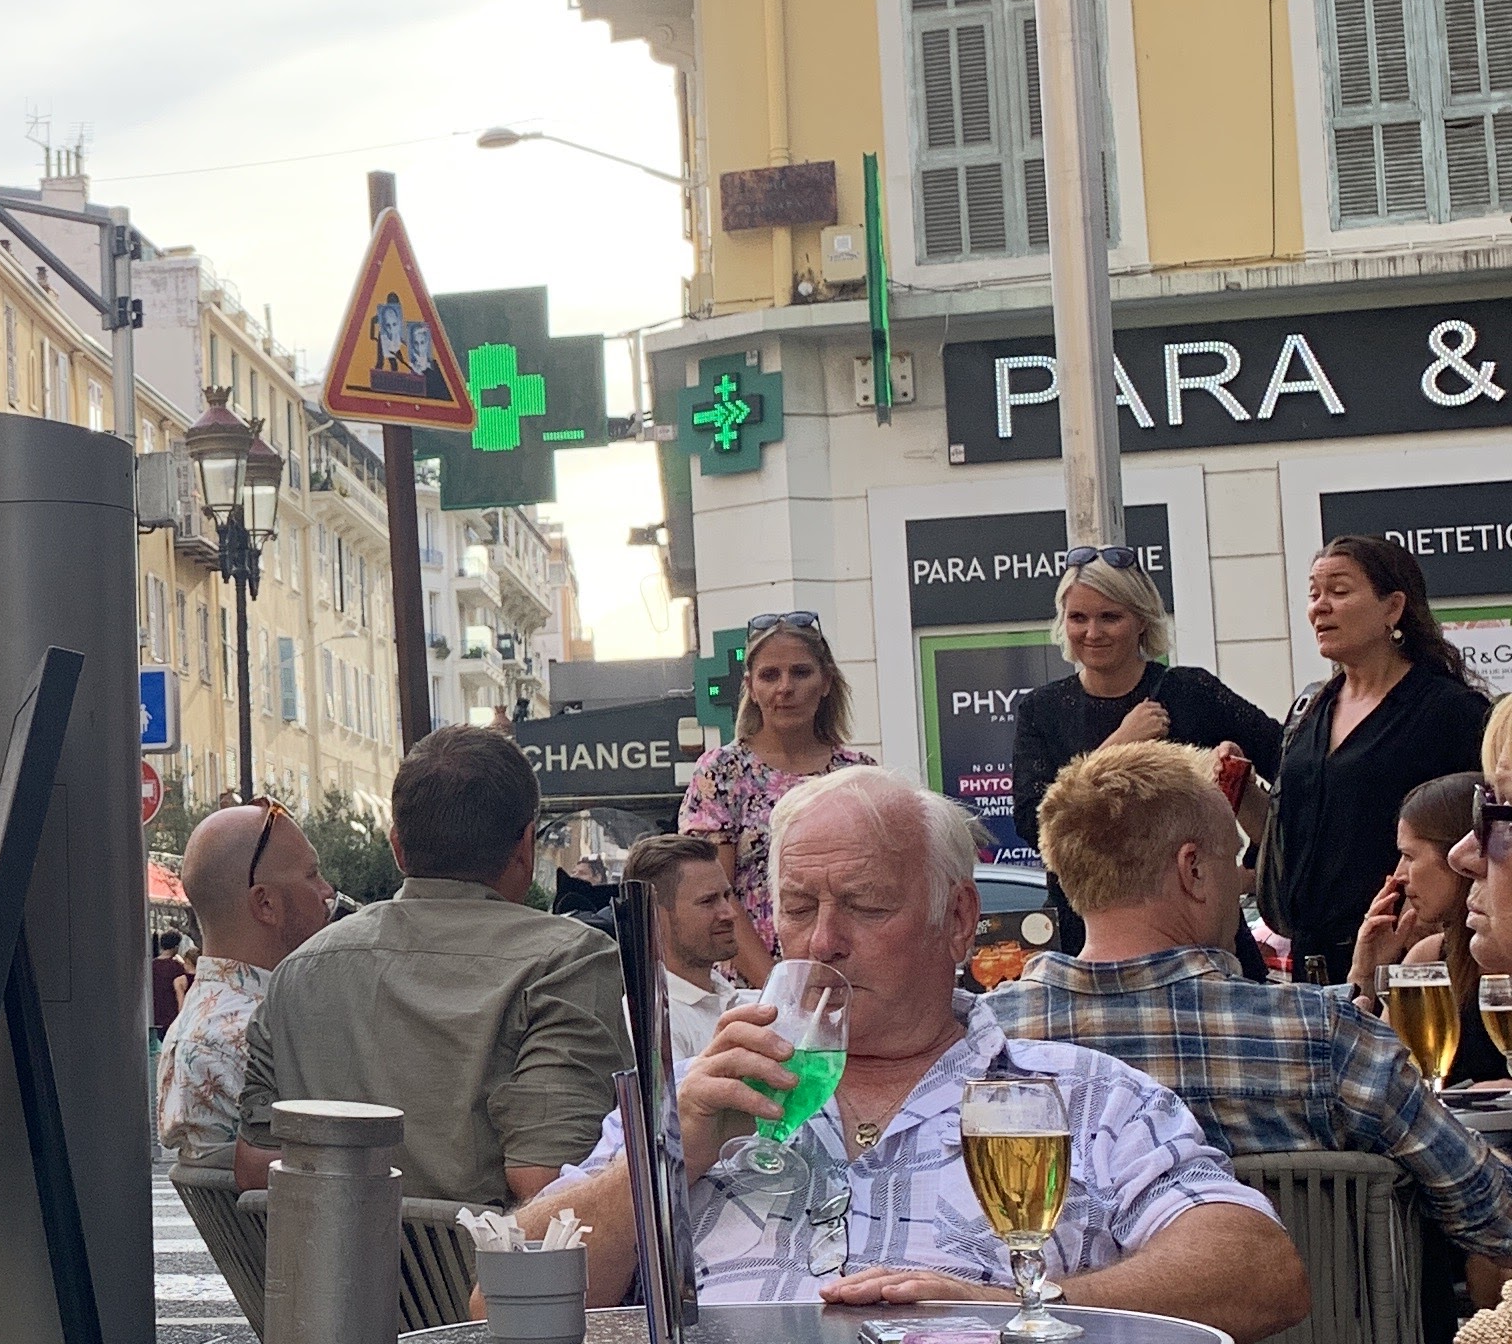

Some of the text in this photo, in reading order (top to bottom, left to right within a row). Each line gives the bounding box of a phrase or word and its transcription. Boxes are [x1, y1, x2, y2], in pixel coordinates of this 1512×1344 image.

[994, 318, 1508, 439] PARA &
[913, 545, 1164, 586] PARA PHARIE
[521, 740, 672, 773] CHANGE
[959, 777, 1013, 792] PHYTO
